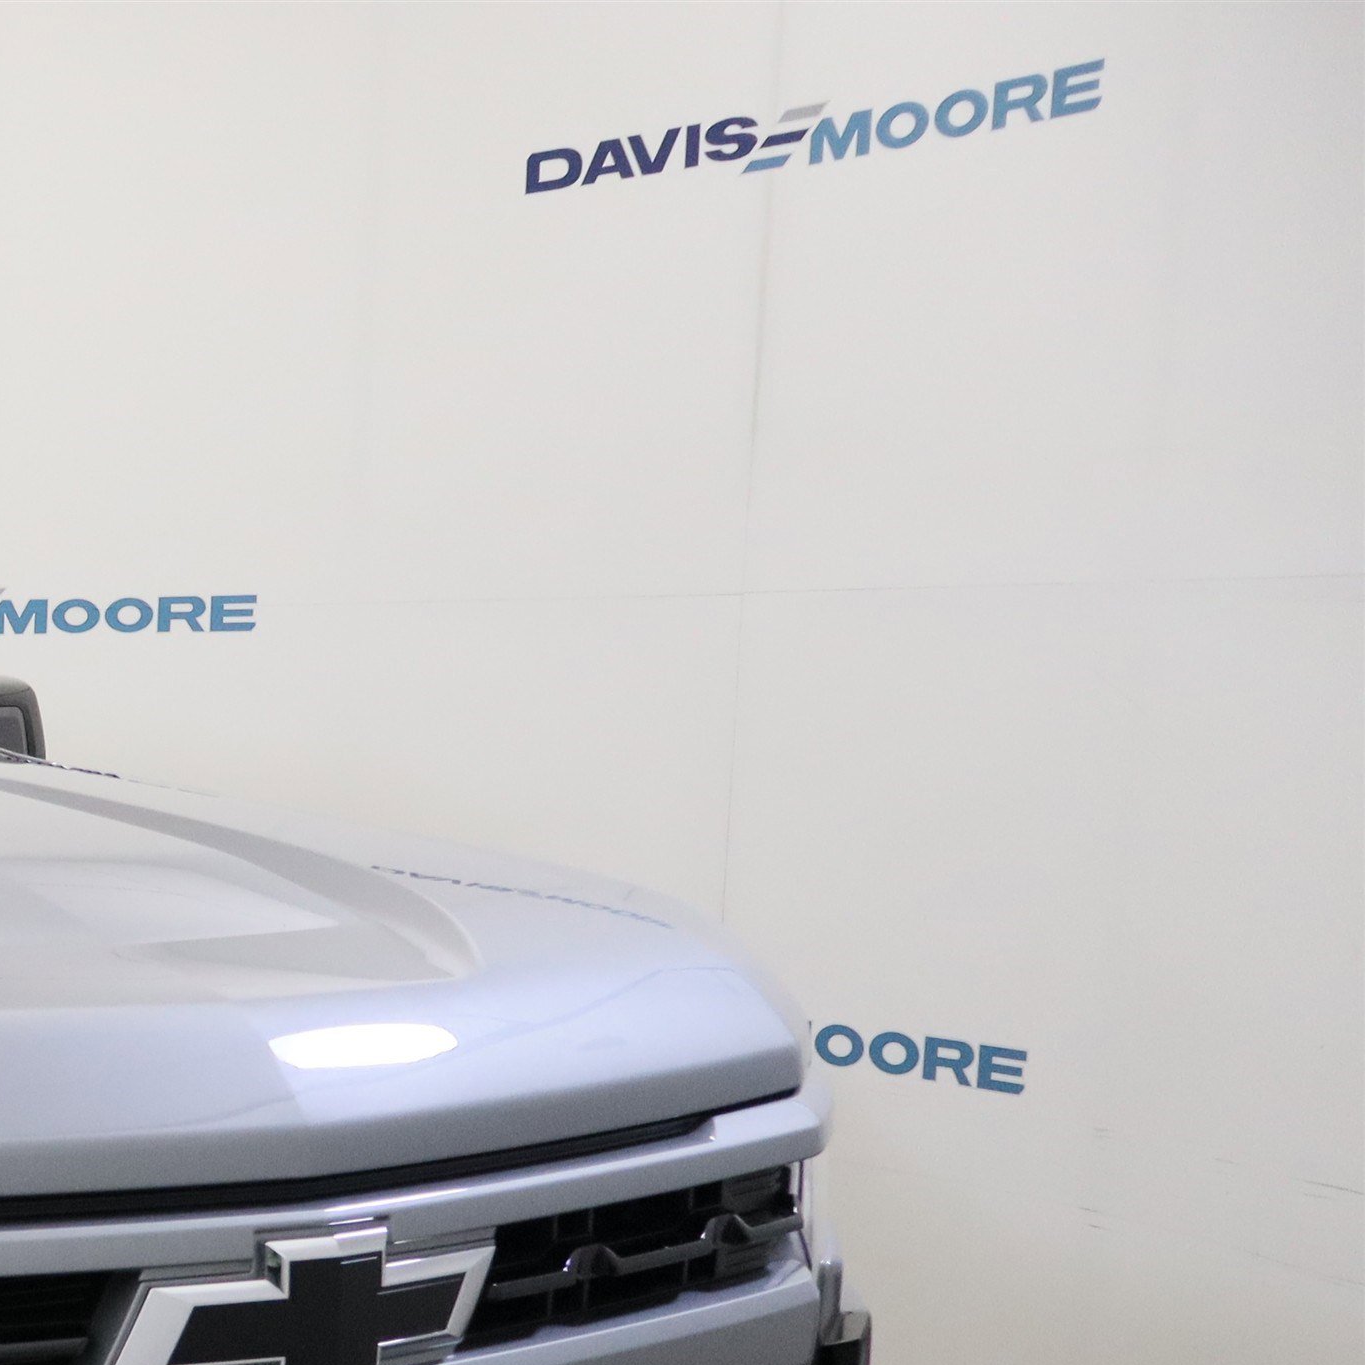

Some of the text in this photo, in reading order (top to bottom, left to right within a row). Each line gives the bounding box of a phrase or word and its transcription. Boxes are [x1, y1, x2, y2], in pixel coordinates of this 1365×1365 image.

[525, 59, 1105, 195] DAVIS MOORE
[814, 1023, 1029, 1096] OORE
